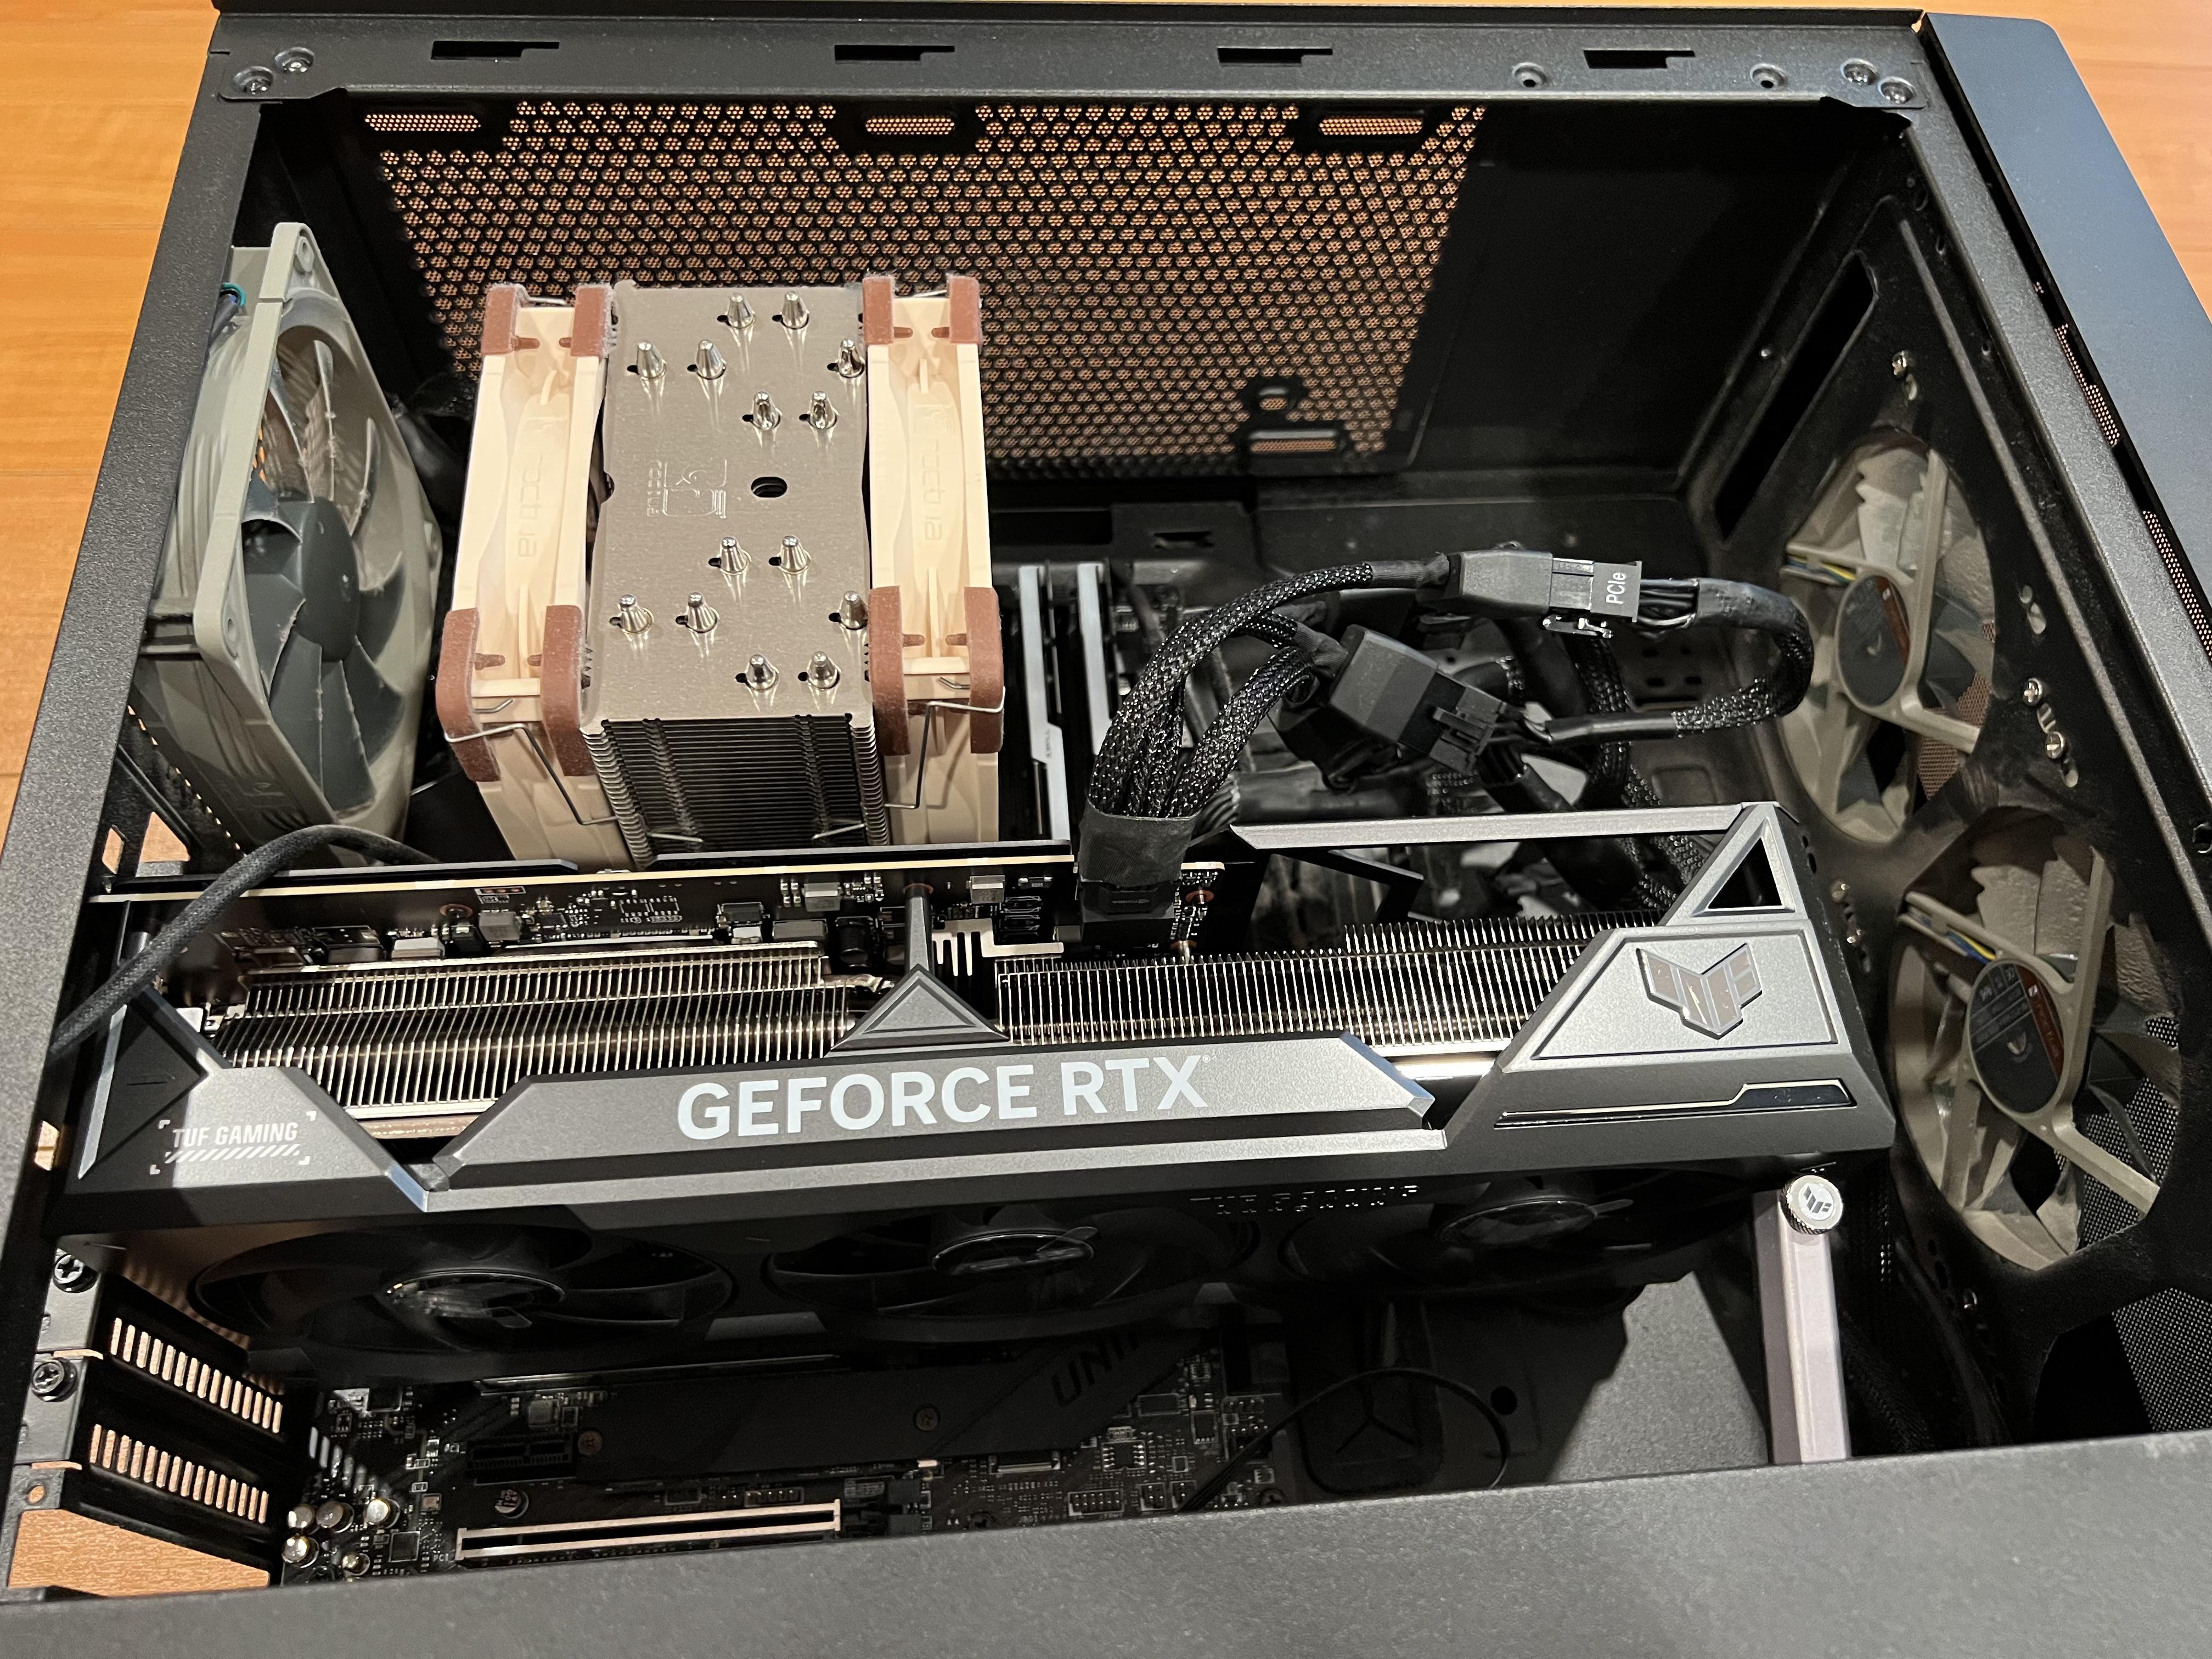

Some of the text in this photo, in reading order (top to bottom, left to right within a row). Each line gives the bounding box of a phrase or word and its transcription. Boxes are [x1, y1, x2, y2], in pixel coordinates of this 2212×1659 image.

[922, 439, 945, 541] noctua
[1606, 572, 1626, 604] PCIe
[678, 1065, 1037, 1140] GEFORCE
[172, 1122, 299, 1148] TUF GAMING
